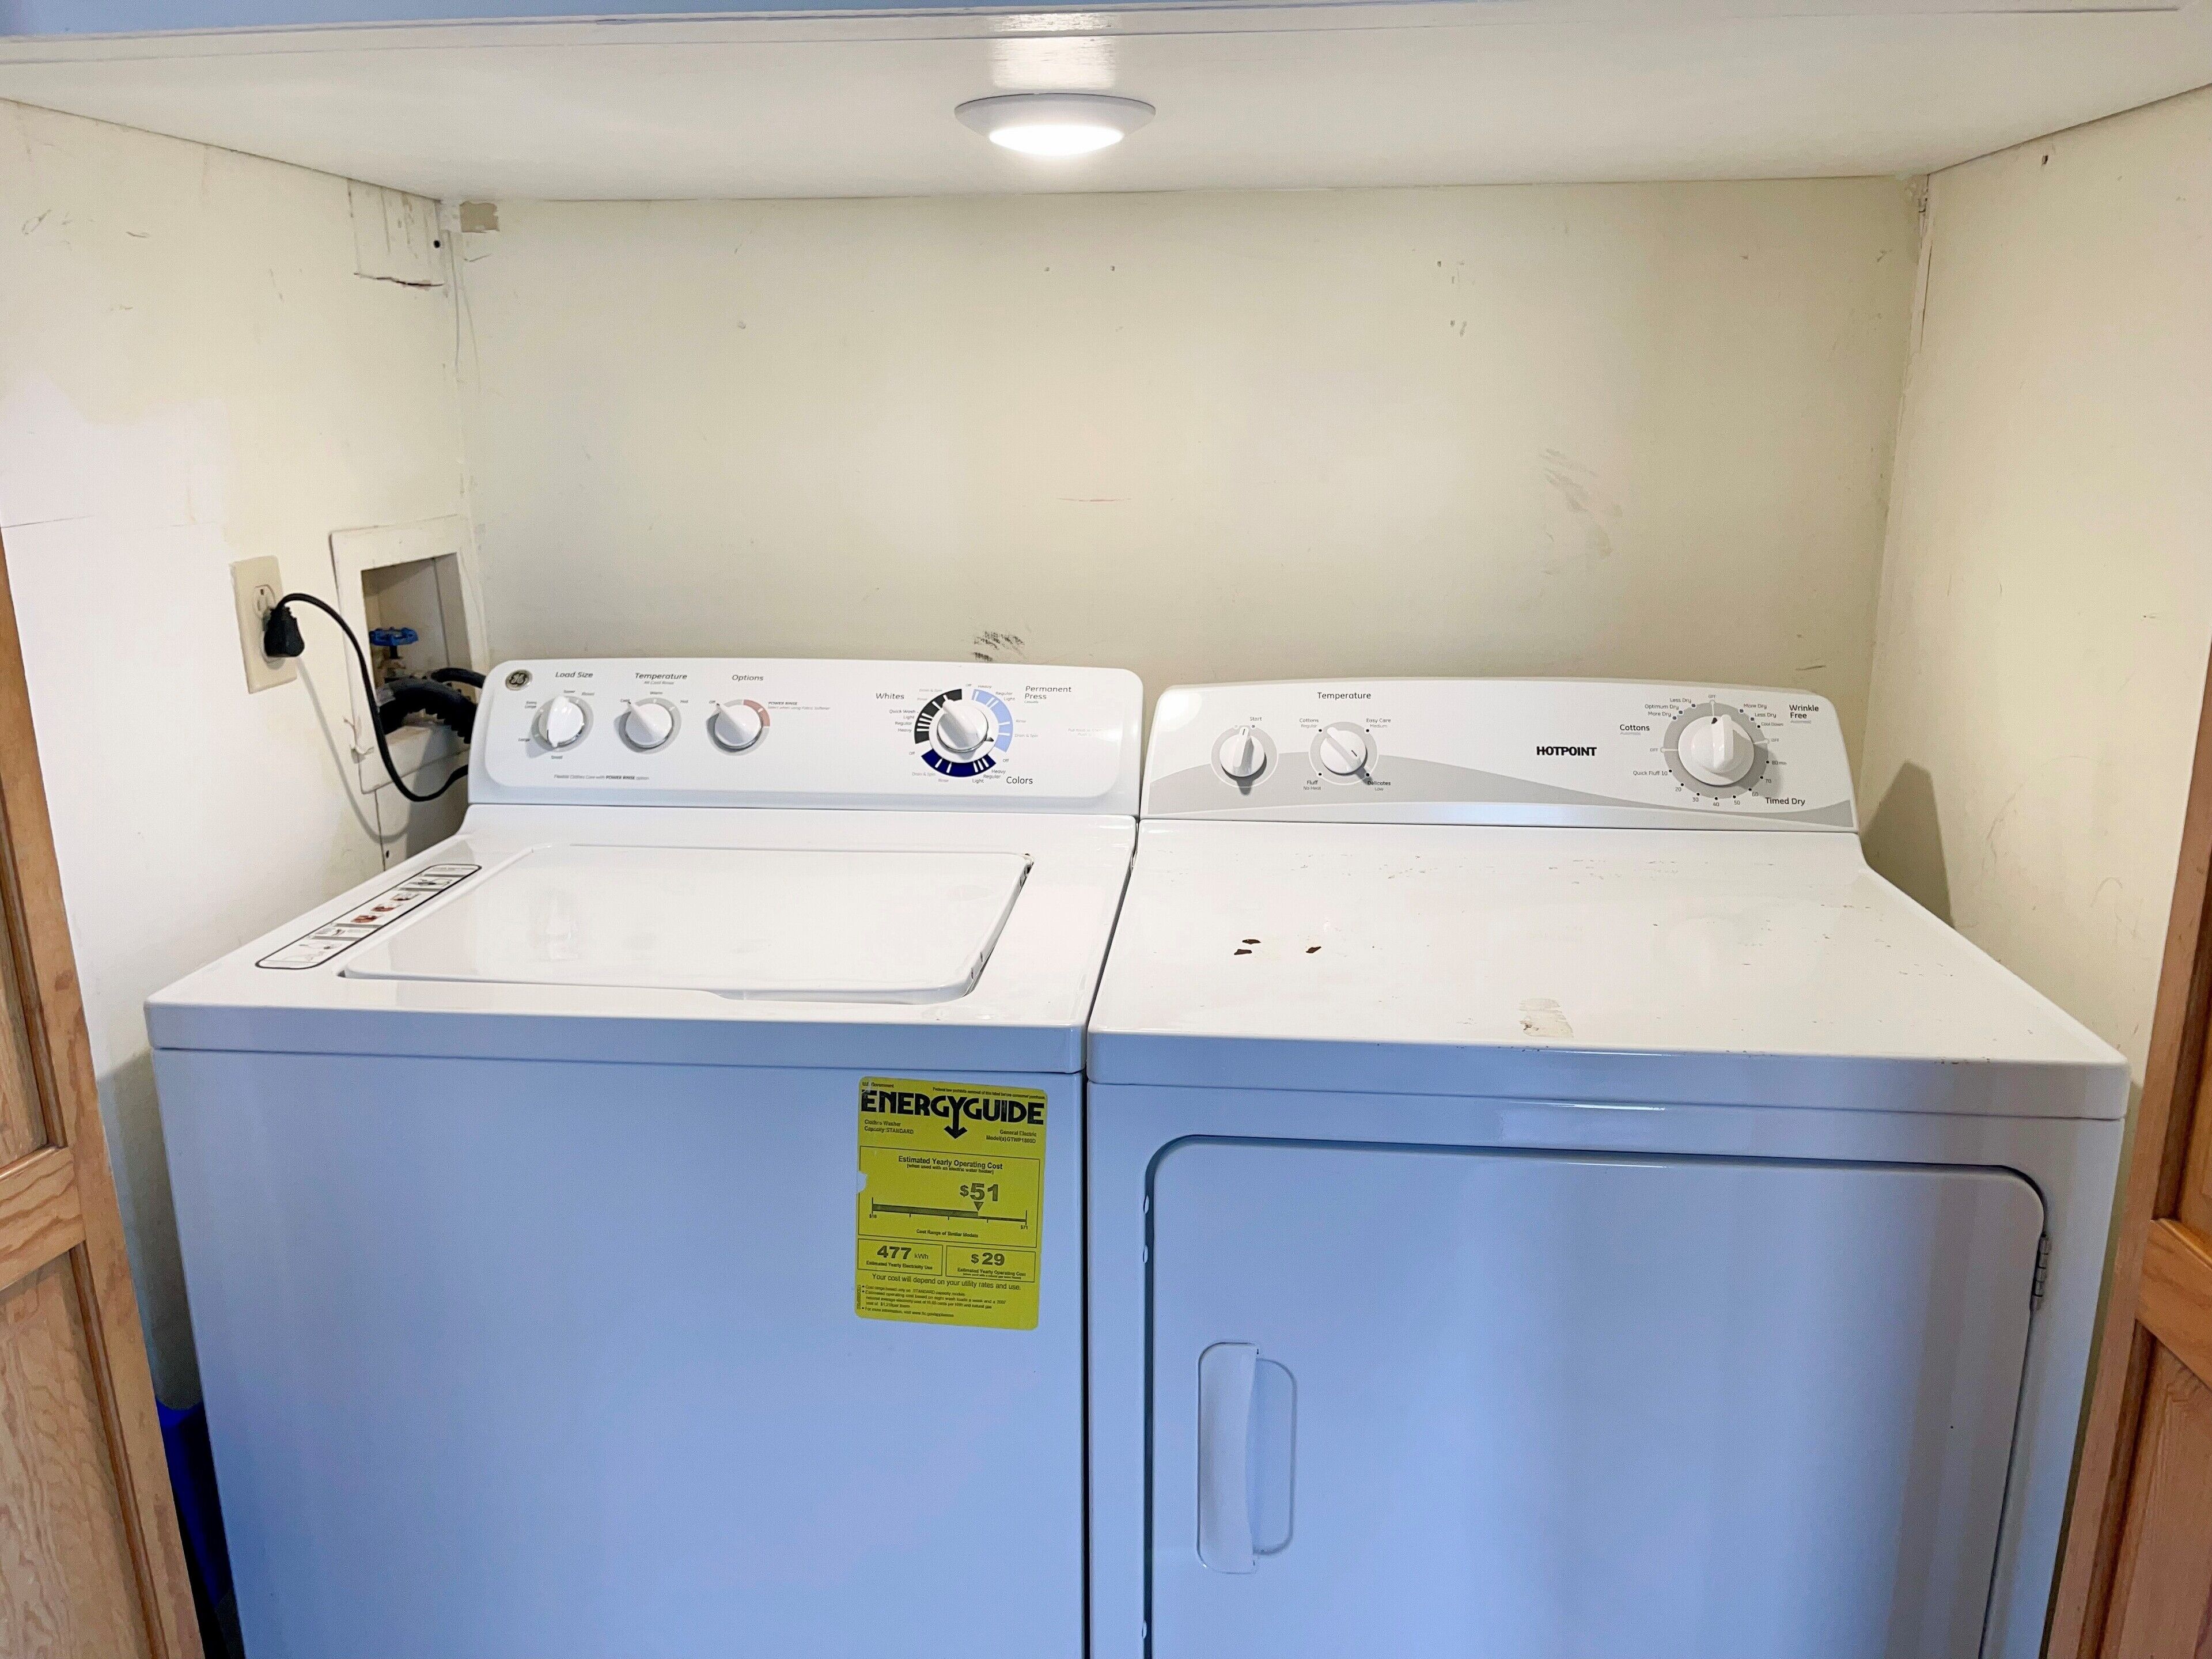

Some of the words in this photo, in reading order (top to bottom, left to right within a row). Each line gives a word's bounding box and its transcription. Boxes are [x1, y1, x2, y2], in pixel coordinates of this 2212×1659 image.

[635, 672, 688, 680] Temperature
[1536, 746, 1597, 756] HOTPOINT
[1791, 798, 1805, 806] Dry
[861, 1089, 1045, 1127] ENERGYGUIDE
[899, 1156, 930, 1164] Estimated
[932, 1158, 952, 1167] Yearly
[954, 1160, 986, 1169] Operating
[960, 1182, 999, 1202] $51
[877, 1245, 912, 1260] 477
[913, 1277, 935, 1285] depend
[961, 1280, 978, 1289] utility
